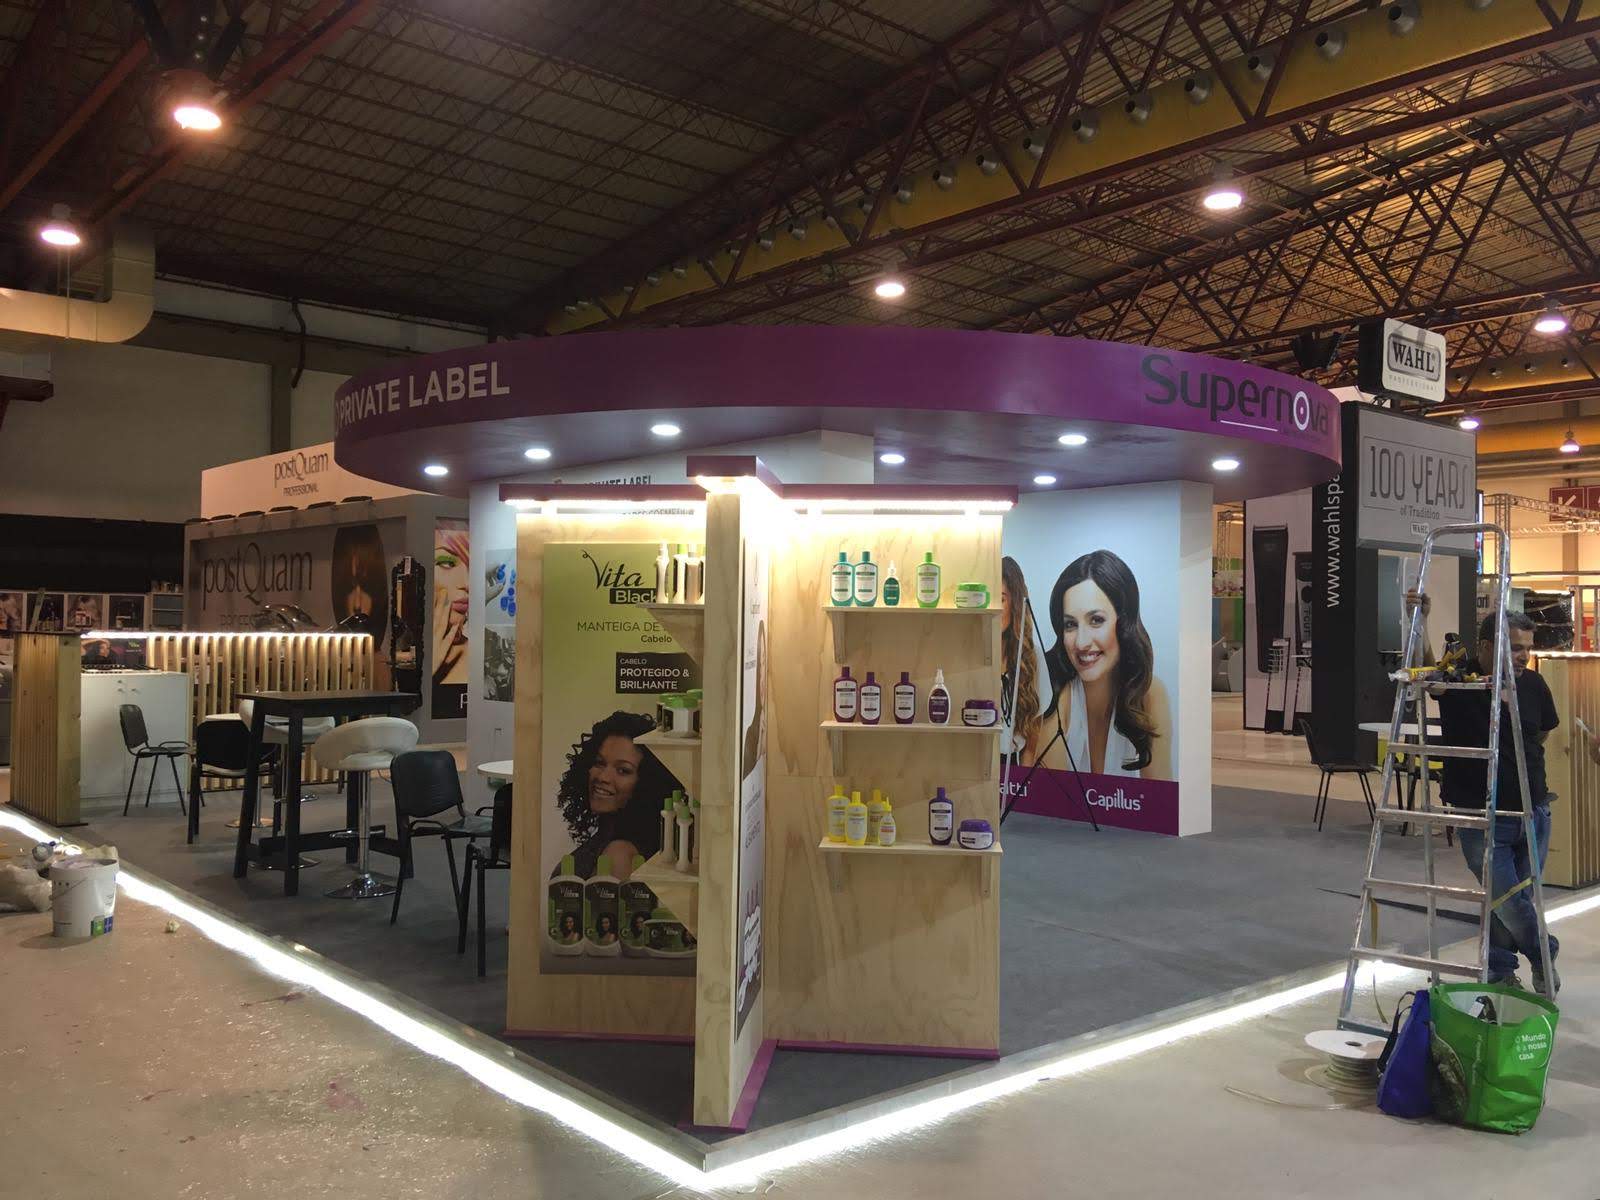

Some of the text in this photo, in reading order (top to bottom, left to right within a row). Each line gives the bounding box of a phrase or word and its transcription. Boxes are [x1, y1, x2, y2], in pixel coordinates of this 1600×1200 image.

[1392, 341, 1435, 373] WAHL
[339, 360, 511, 429] PRIVATE LABEL
[274, 451, 329, 489] postQuam
[1370, 446, 1469, 510] 100 YEARS
[203, 542, 313, 612] postQuam
[581, 549, 646, 590] Vita
[615, 589, 657, 604] Black
[576, 621, 660, 632] MANTEIGA DE
[640, 634, 673, 643] Cabelo
[620, 668, 690, 678] PROTEGIDO &
[620, 680, 678, 689] BRILHANTE
[1085, 788, 1142, 811] Capillus
